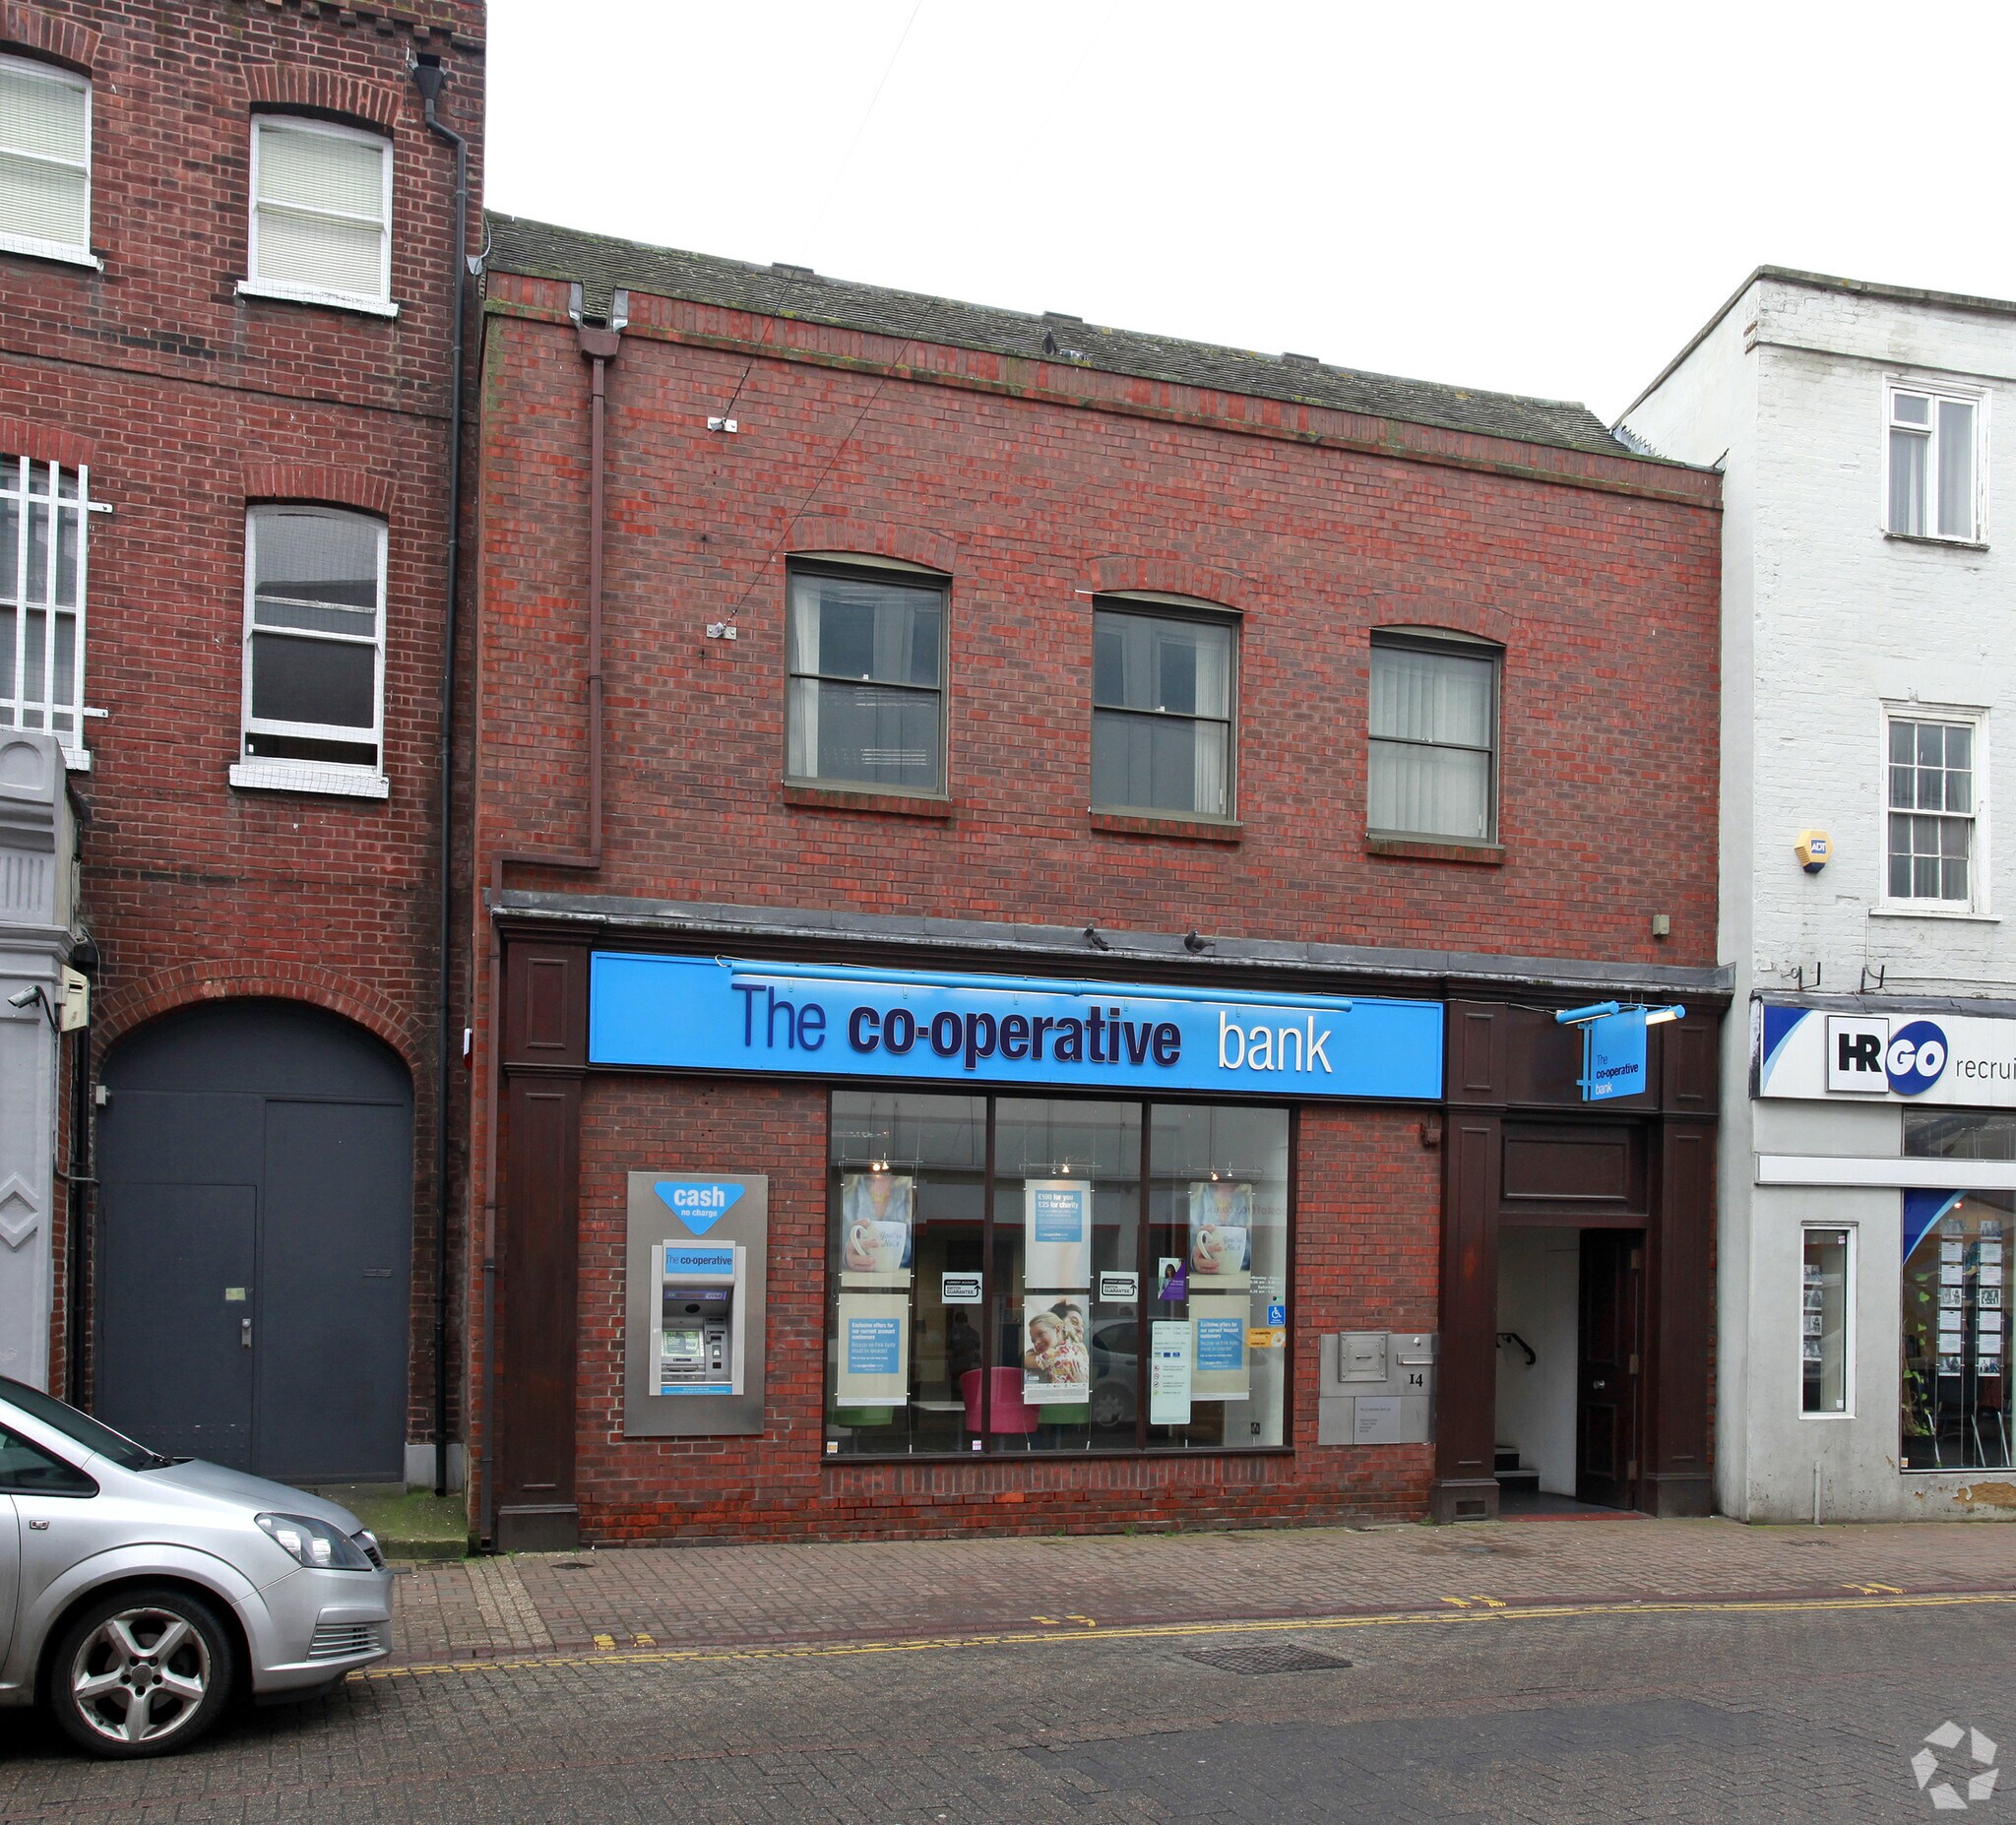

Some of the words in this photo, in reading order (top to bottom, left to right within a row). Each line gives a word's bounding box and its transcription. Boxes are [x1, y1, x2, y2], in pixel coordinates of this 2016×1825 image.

[1811, 842, 1827, 851] ADT
[731, 983, 827, 1050] The
[848, 1004, 1182, 1070] co-operative
[1218, 1011, 1333, 1073] bank
[1597, 1054, 1608, 1066] The
[1596, 1063, 1639, 1080] co-operative
[1595, 1082, 1612, 1096] bank
[673, 1186, 725, 1208] cash
[1059, 1201, 1079, 1210] charity
[692, 1209, 718, 1218] charge
[666, 1254, 679, 1265] The
[680, 1256, 732, 1266] co-operative
[1409, 1373, 1423, 1387] 14
